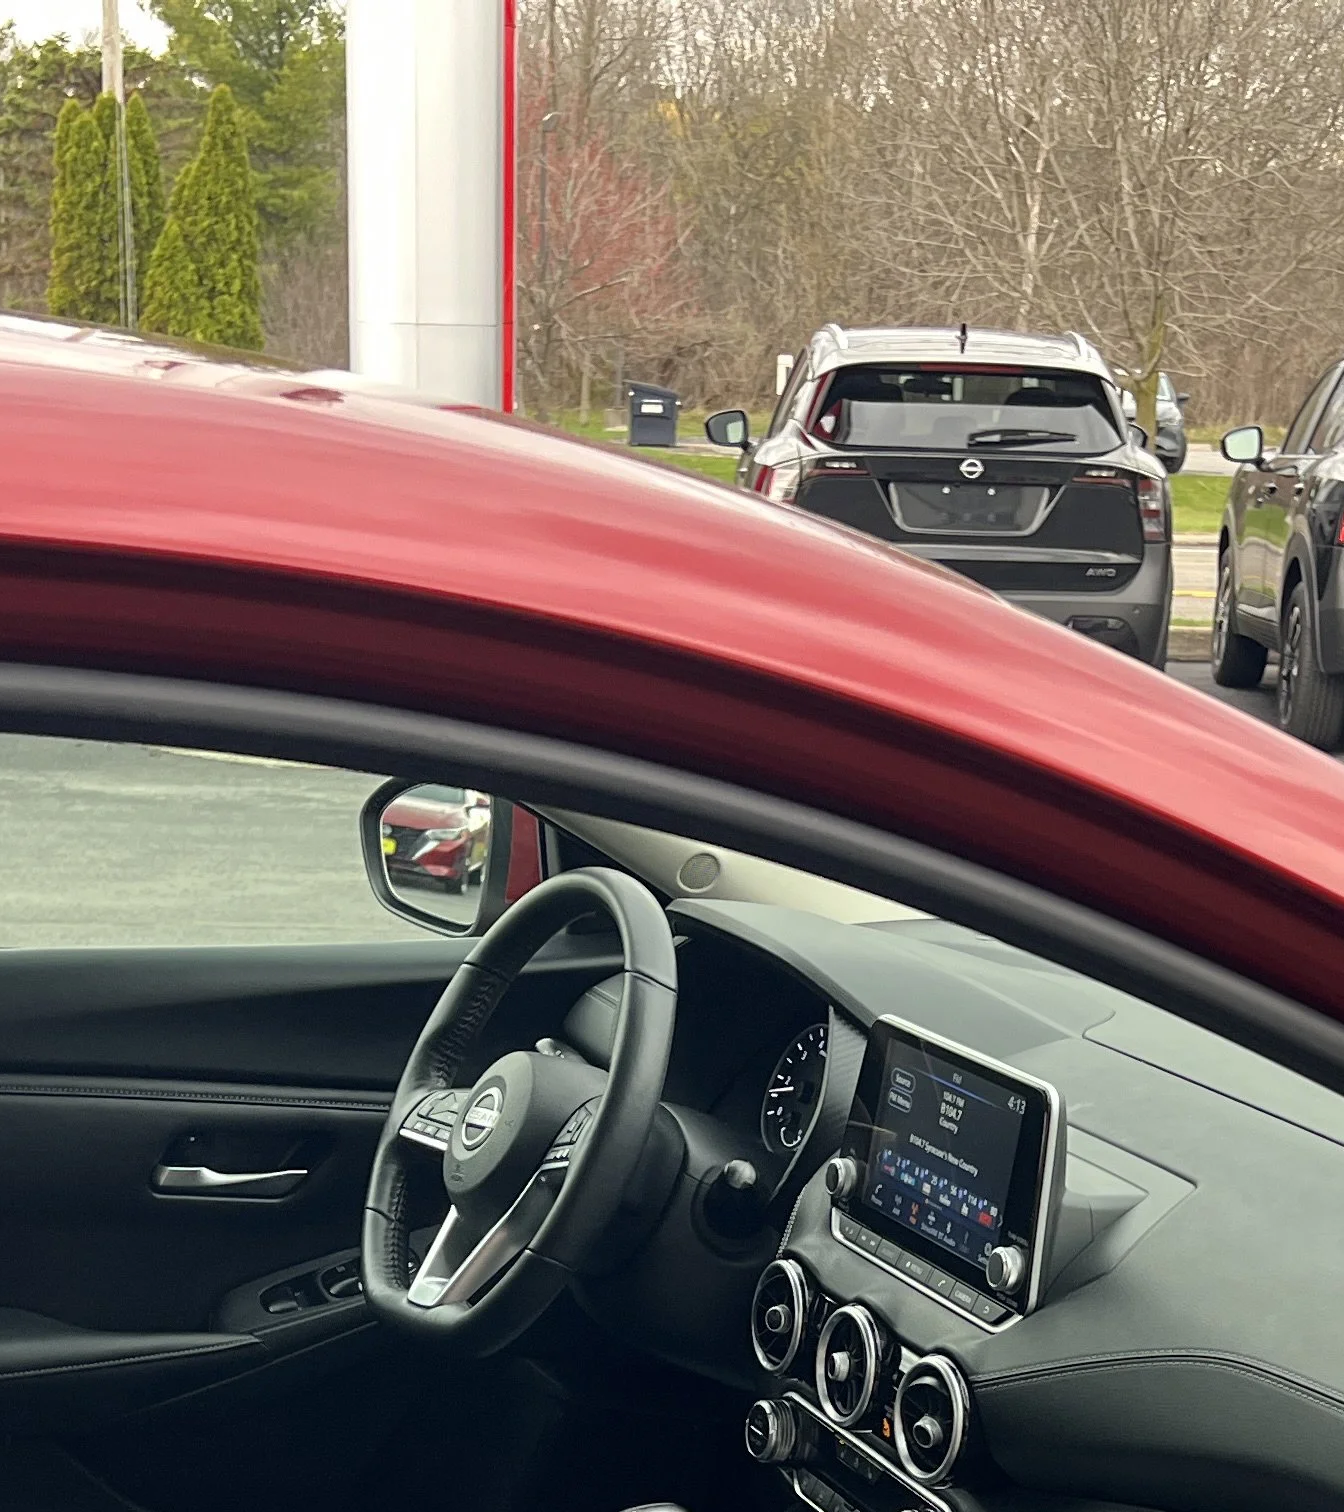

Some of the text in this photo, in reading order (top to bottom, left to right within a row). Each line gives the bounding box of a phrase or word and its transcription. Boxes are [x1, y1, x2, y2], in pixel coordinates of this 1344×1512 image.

[1007, 1095, 1026, 1115] 4:13
[938, 1116, 959, 1135] Country
[958, 1158, 979, 1178] Country
